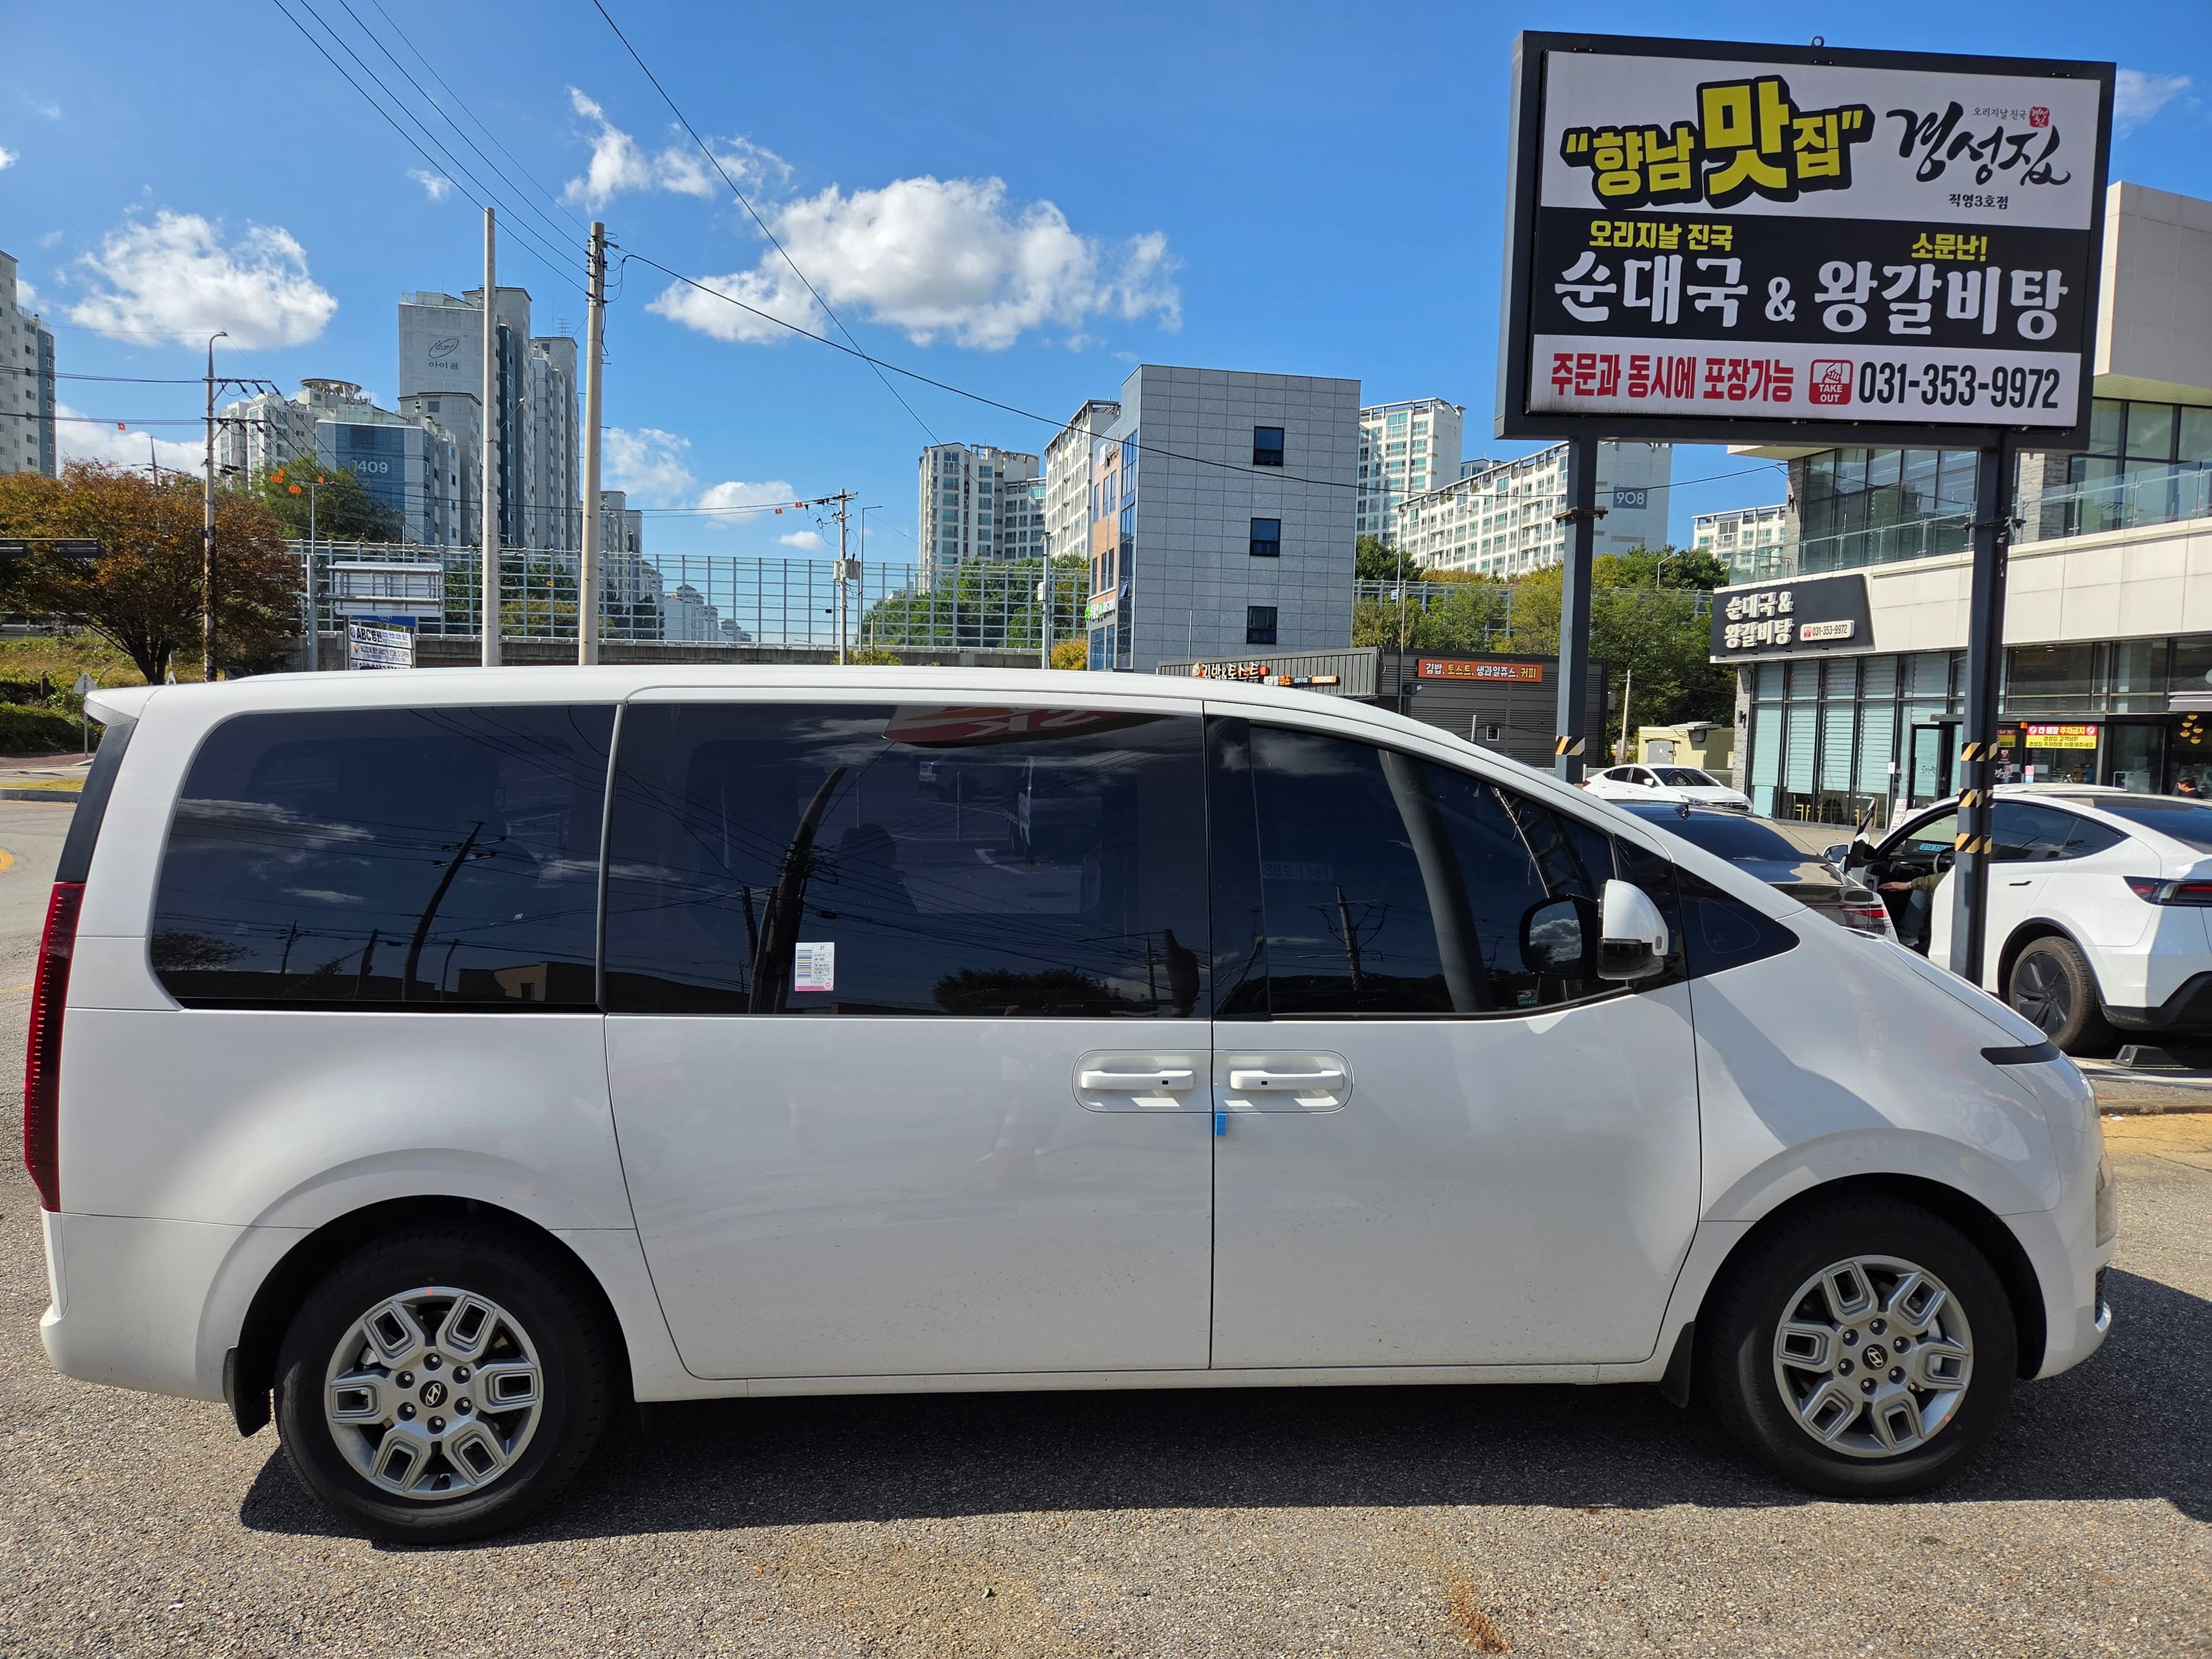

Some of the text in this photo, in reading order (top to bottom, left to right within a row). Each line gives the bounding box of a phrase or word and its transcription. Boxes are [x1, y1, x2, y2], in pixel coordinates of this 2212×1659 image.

[1973, 107, 2027, 120] 오리지날 진국
[1886, 101, 2071, 186] 경성집
[1949, 193, 2009, 210] 직영3호점
[1589, 220, 1733, 251] 오리지날 진국
[1911, 233, 1988, 262] 소문난!
[1555, 251, 2069, 340] 순대국 & 왕갈비탕
[1551, 353, 1794, 403] 주문과 동시에 포장가능
[1819, 384, 1843, 393] TAKE
[1858, 361, 2061, 409] 031-353-9972
[1820, 394, 1840, 403] OUT
[1616, 491, 1645, 505] 908
[1725, 591, 1794, 620] 순대국 &
[1724, 618, 1795, 649] 왕갈비탕
[1812, 624, 1848, 637] 031-353-9972
[1426, 663, 1445, 675] 김밥,
[1447, 664, 1474, 676] 토스트,
[1520, 667, 1537, 679] 커피
